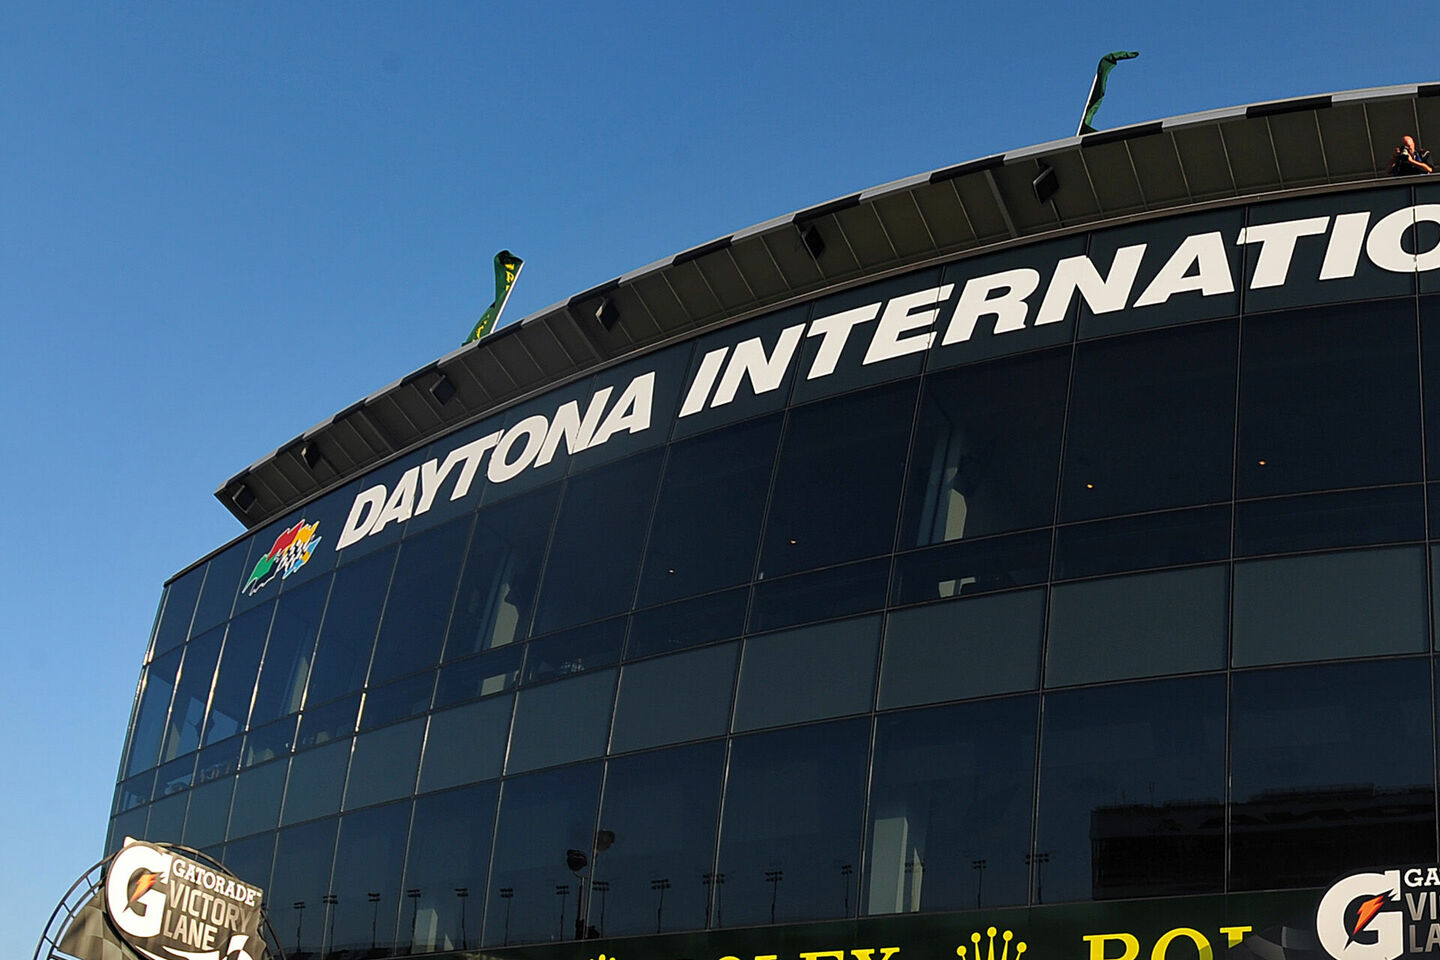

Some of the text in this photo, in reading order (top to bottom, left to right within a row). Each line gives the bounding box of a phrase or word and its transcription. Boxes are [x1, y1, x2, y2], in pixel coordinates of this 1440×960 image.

[335, 371, 656, 551] DAYTONA
[107, 844, 173, 938] G
[169, 879, 250, 935] VICTORY
[163, 909, 220, 952] LANE
